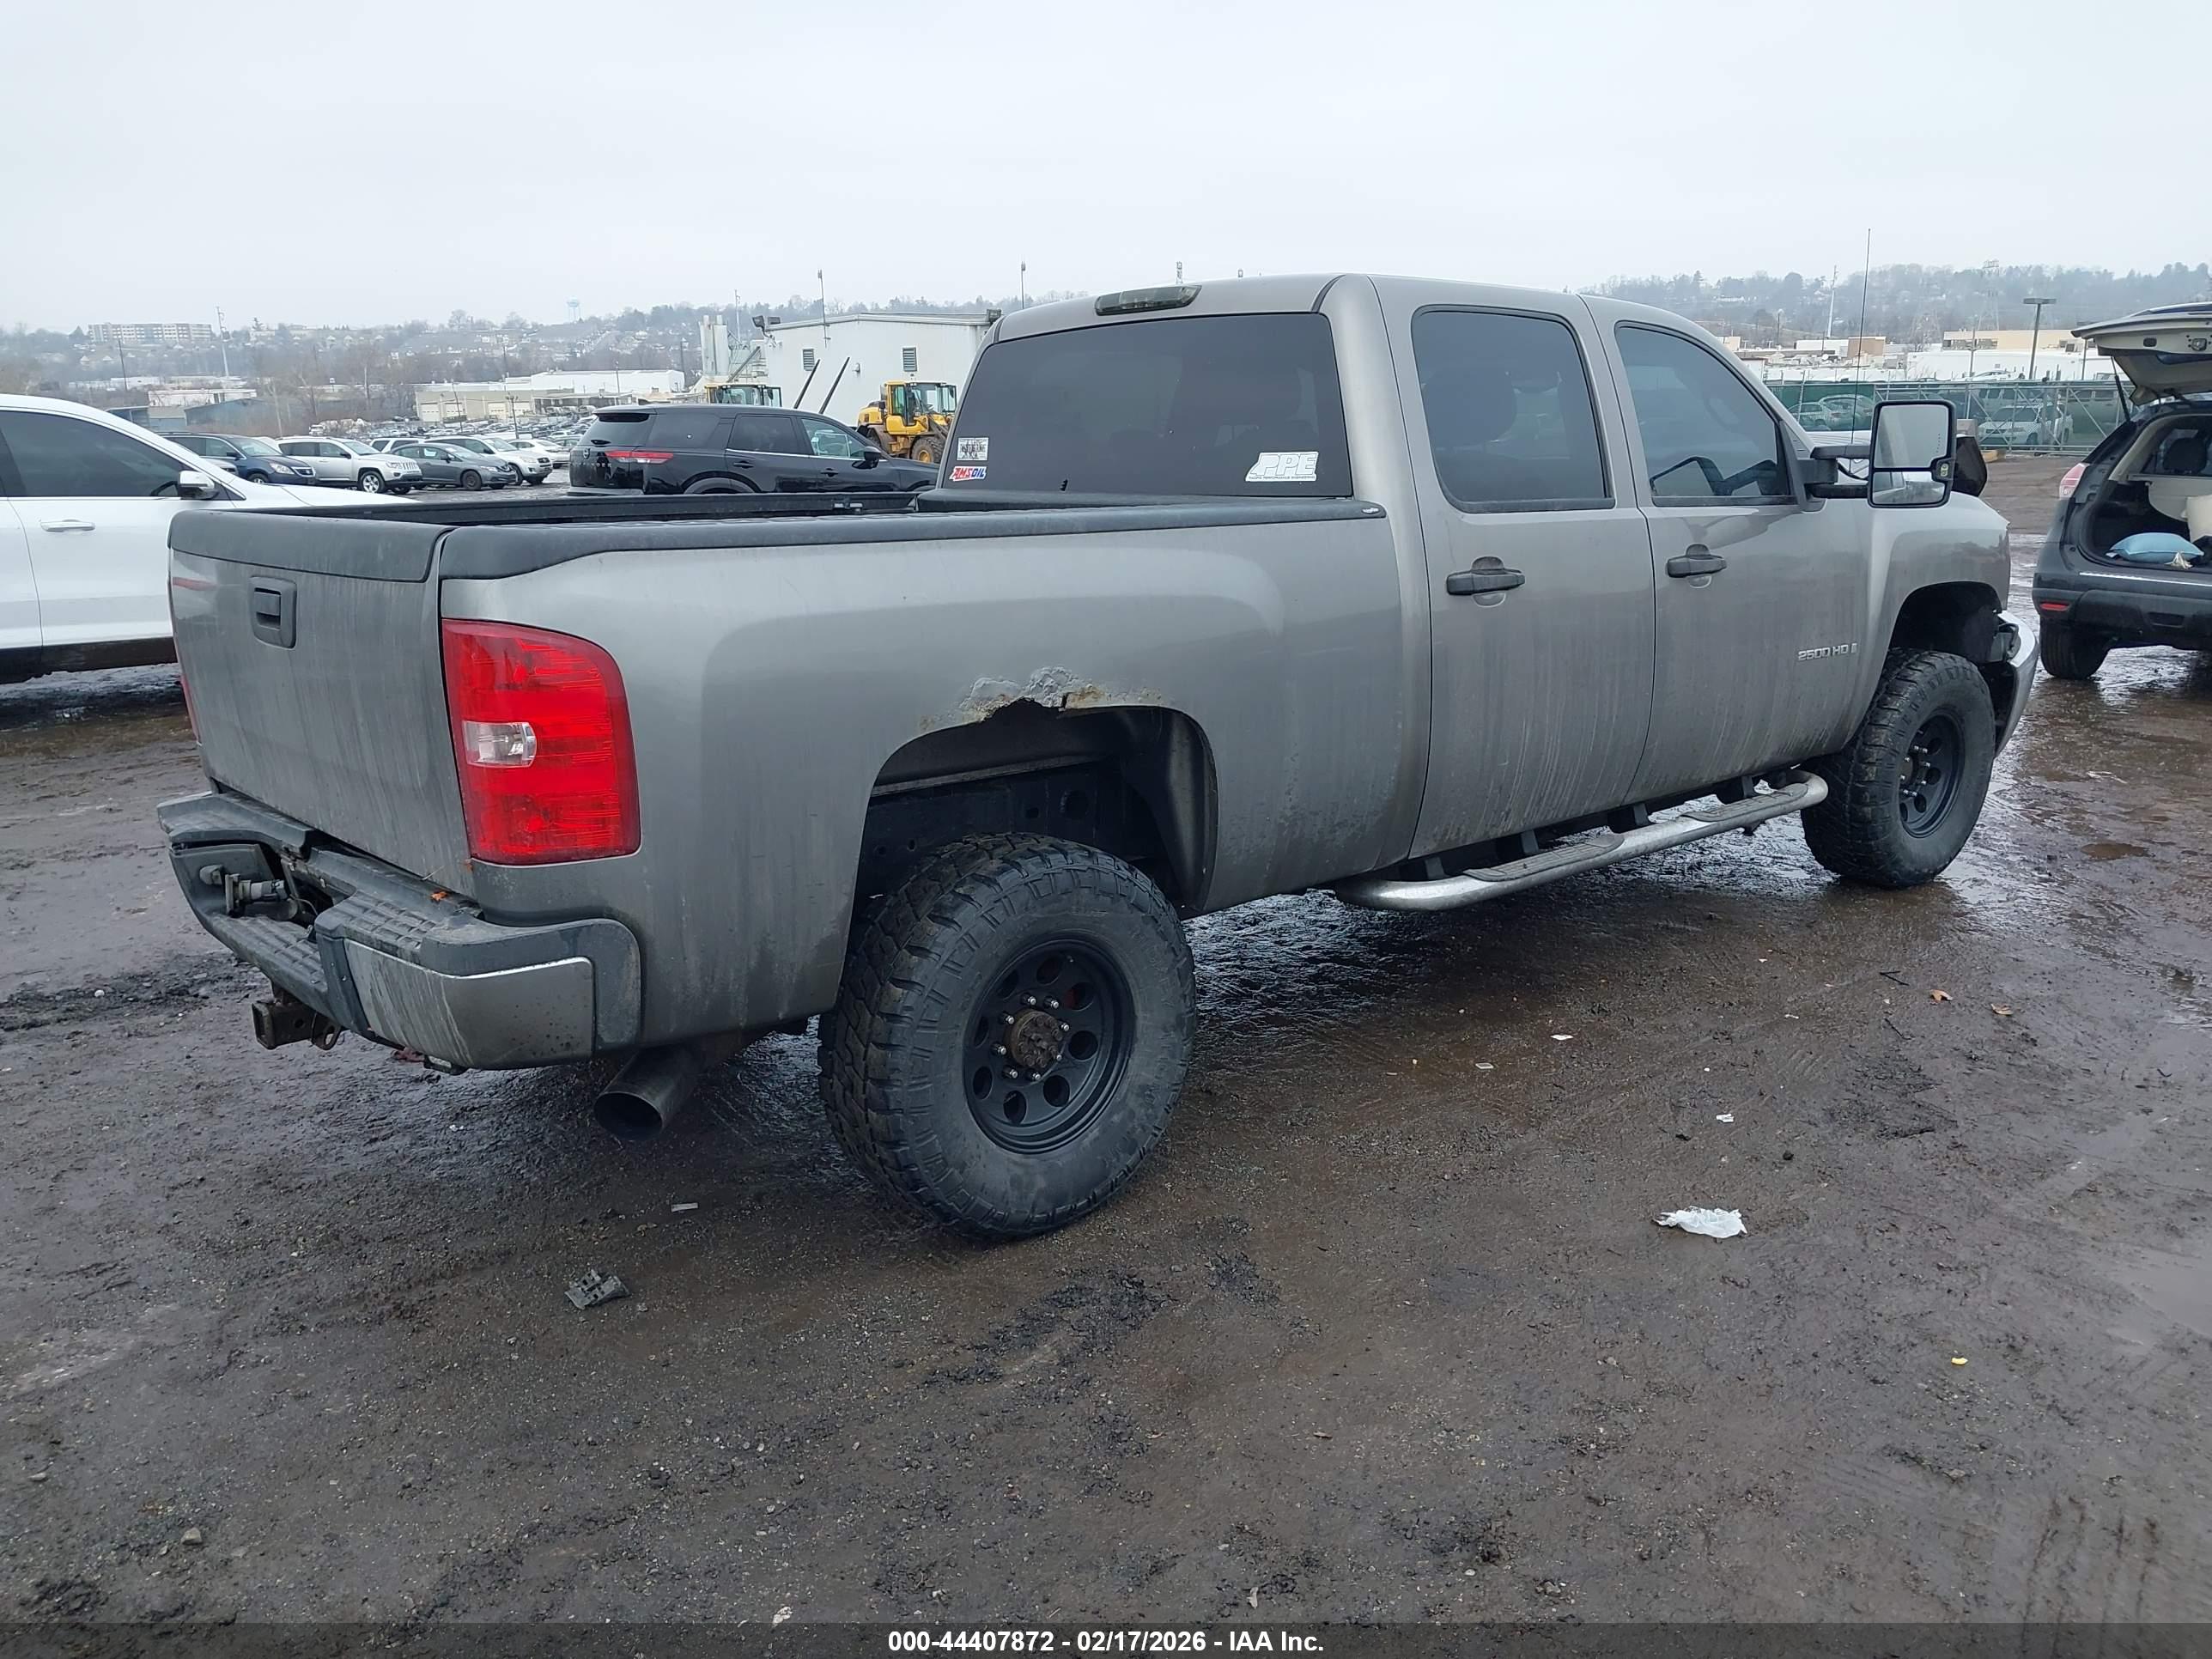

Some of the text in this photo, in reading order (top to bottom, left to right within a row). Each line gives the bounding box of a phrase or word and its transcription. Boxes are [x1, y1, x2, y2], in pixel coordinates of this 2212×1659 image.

[1250, 453, 1317, 476] PPE
[951, 467, 985, 479] AMSOIL
[1798, 644, 1849, 660] 2500 HD
